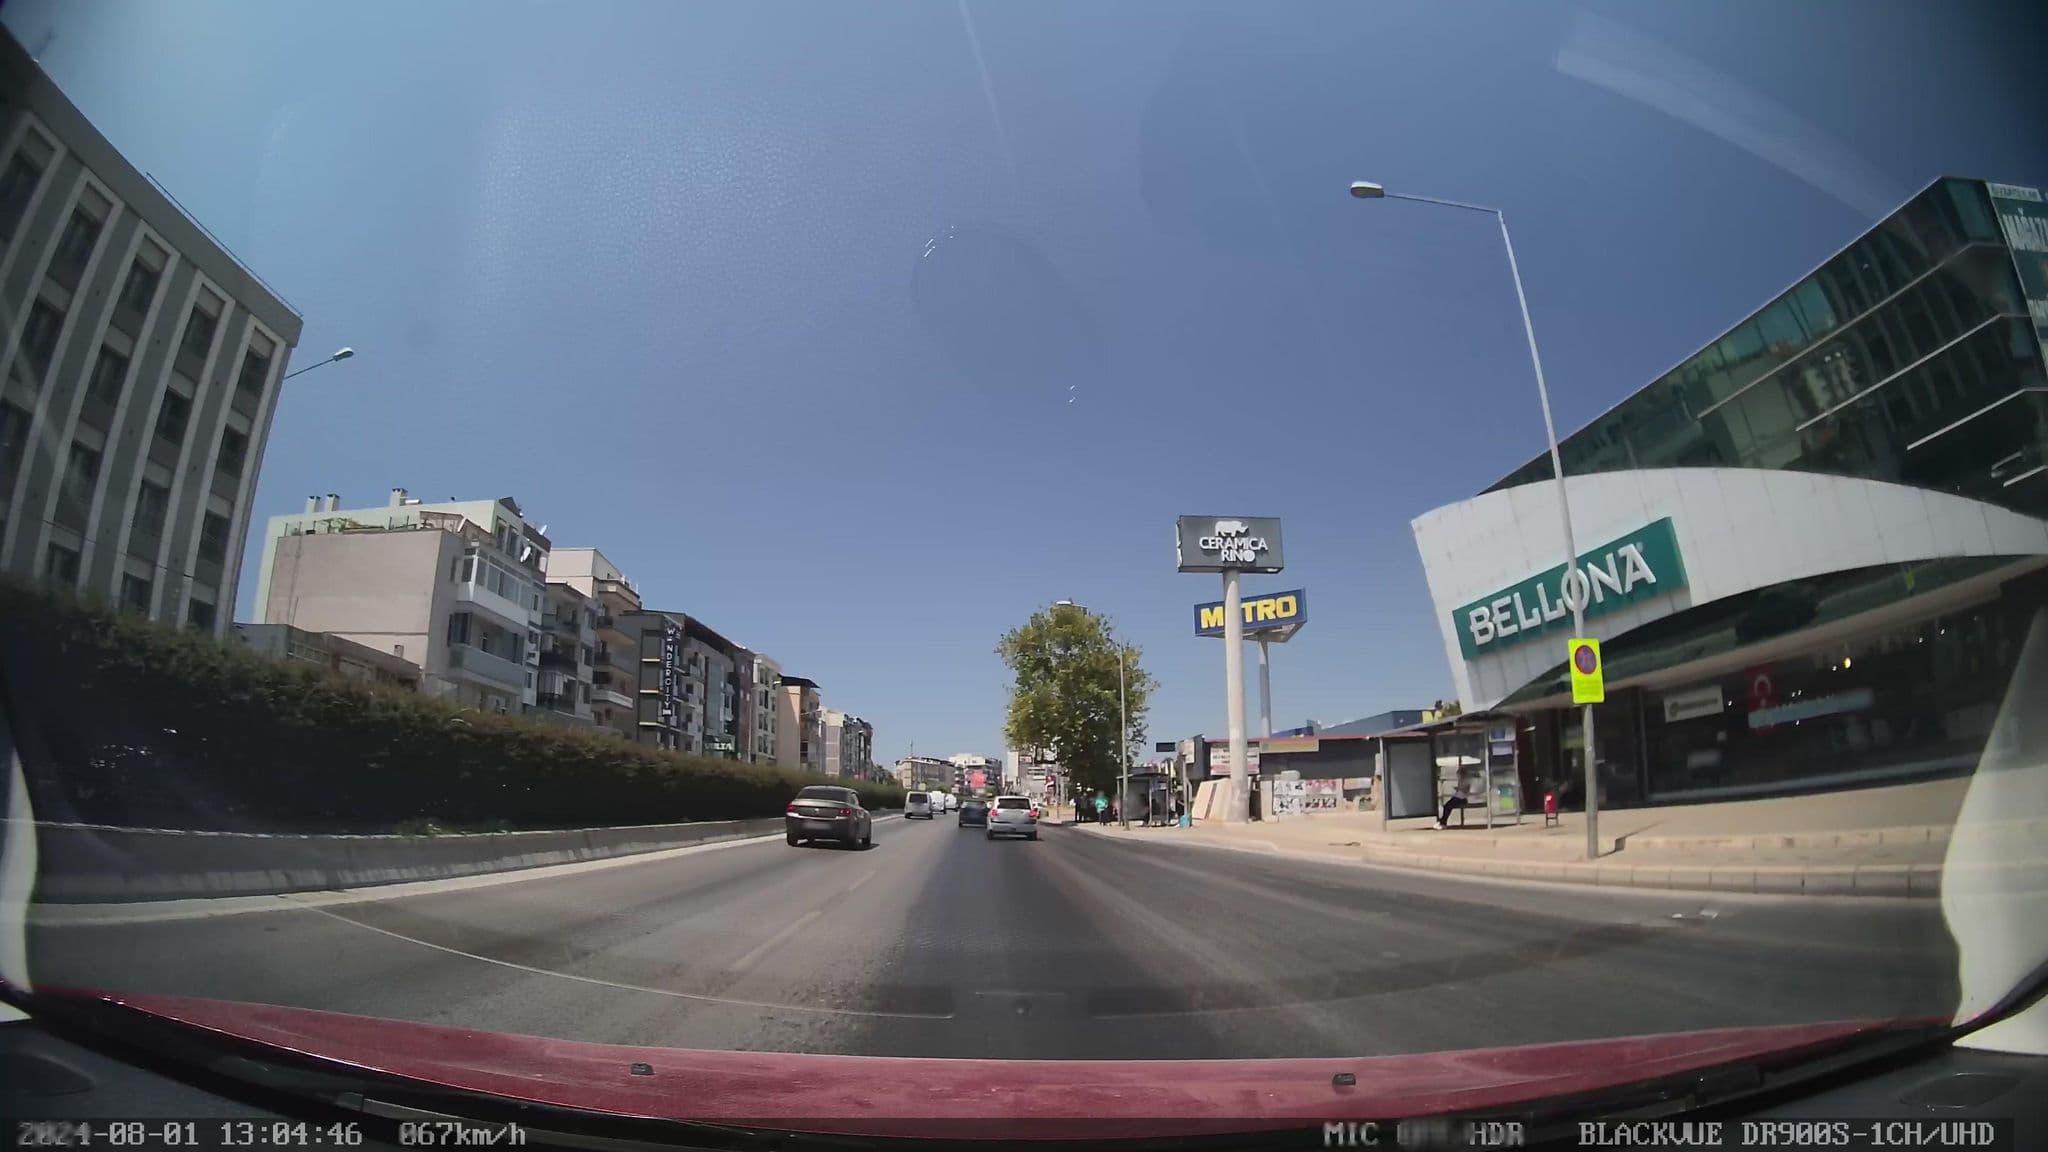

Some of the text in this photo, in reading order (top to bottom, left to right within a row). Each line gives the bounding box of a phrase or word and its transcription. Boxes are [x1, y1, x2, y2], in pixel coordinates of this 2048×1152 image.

[1199, 536, 1268, 551] CERAMICA
[1221, 549, 1256, 562] RINO
[1469, 543, 1657, 646] BELLONA
[1200, 595, 1297, 629] MTRO
